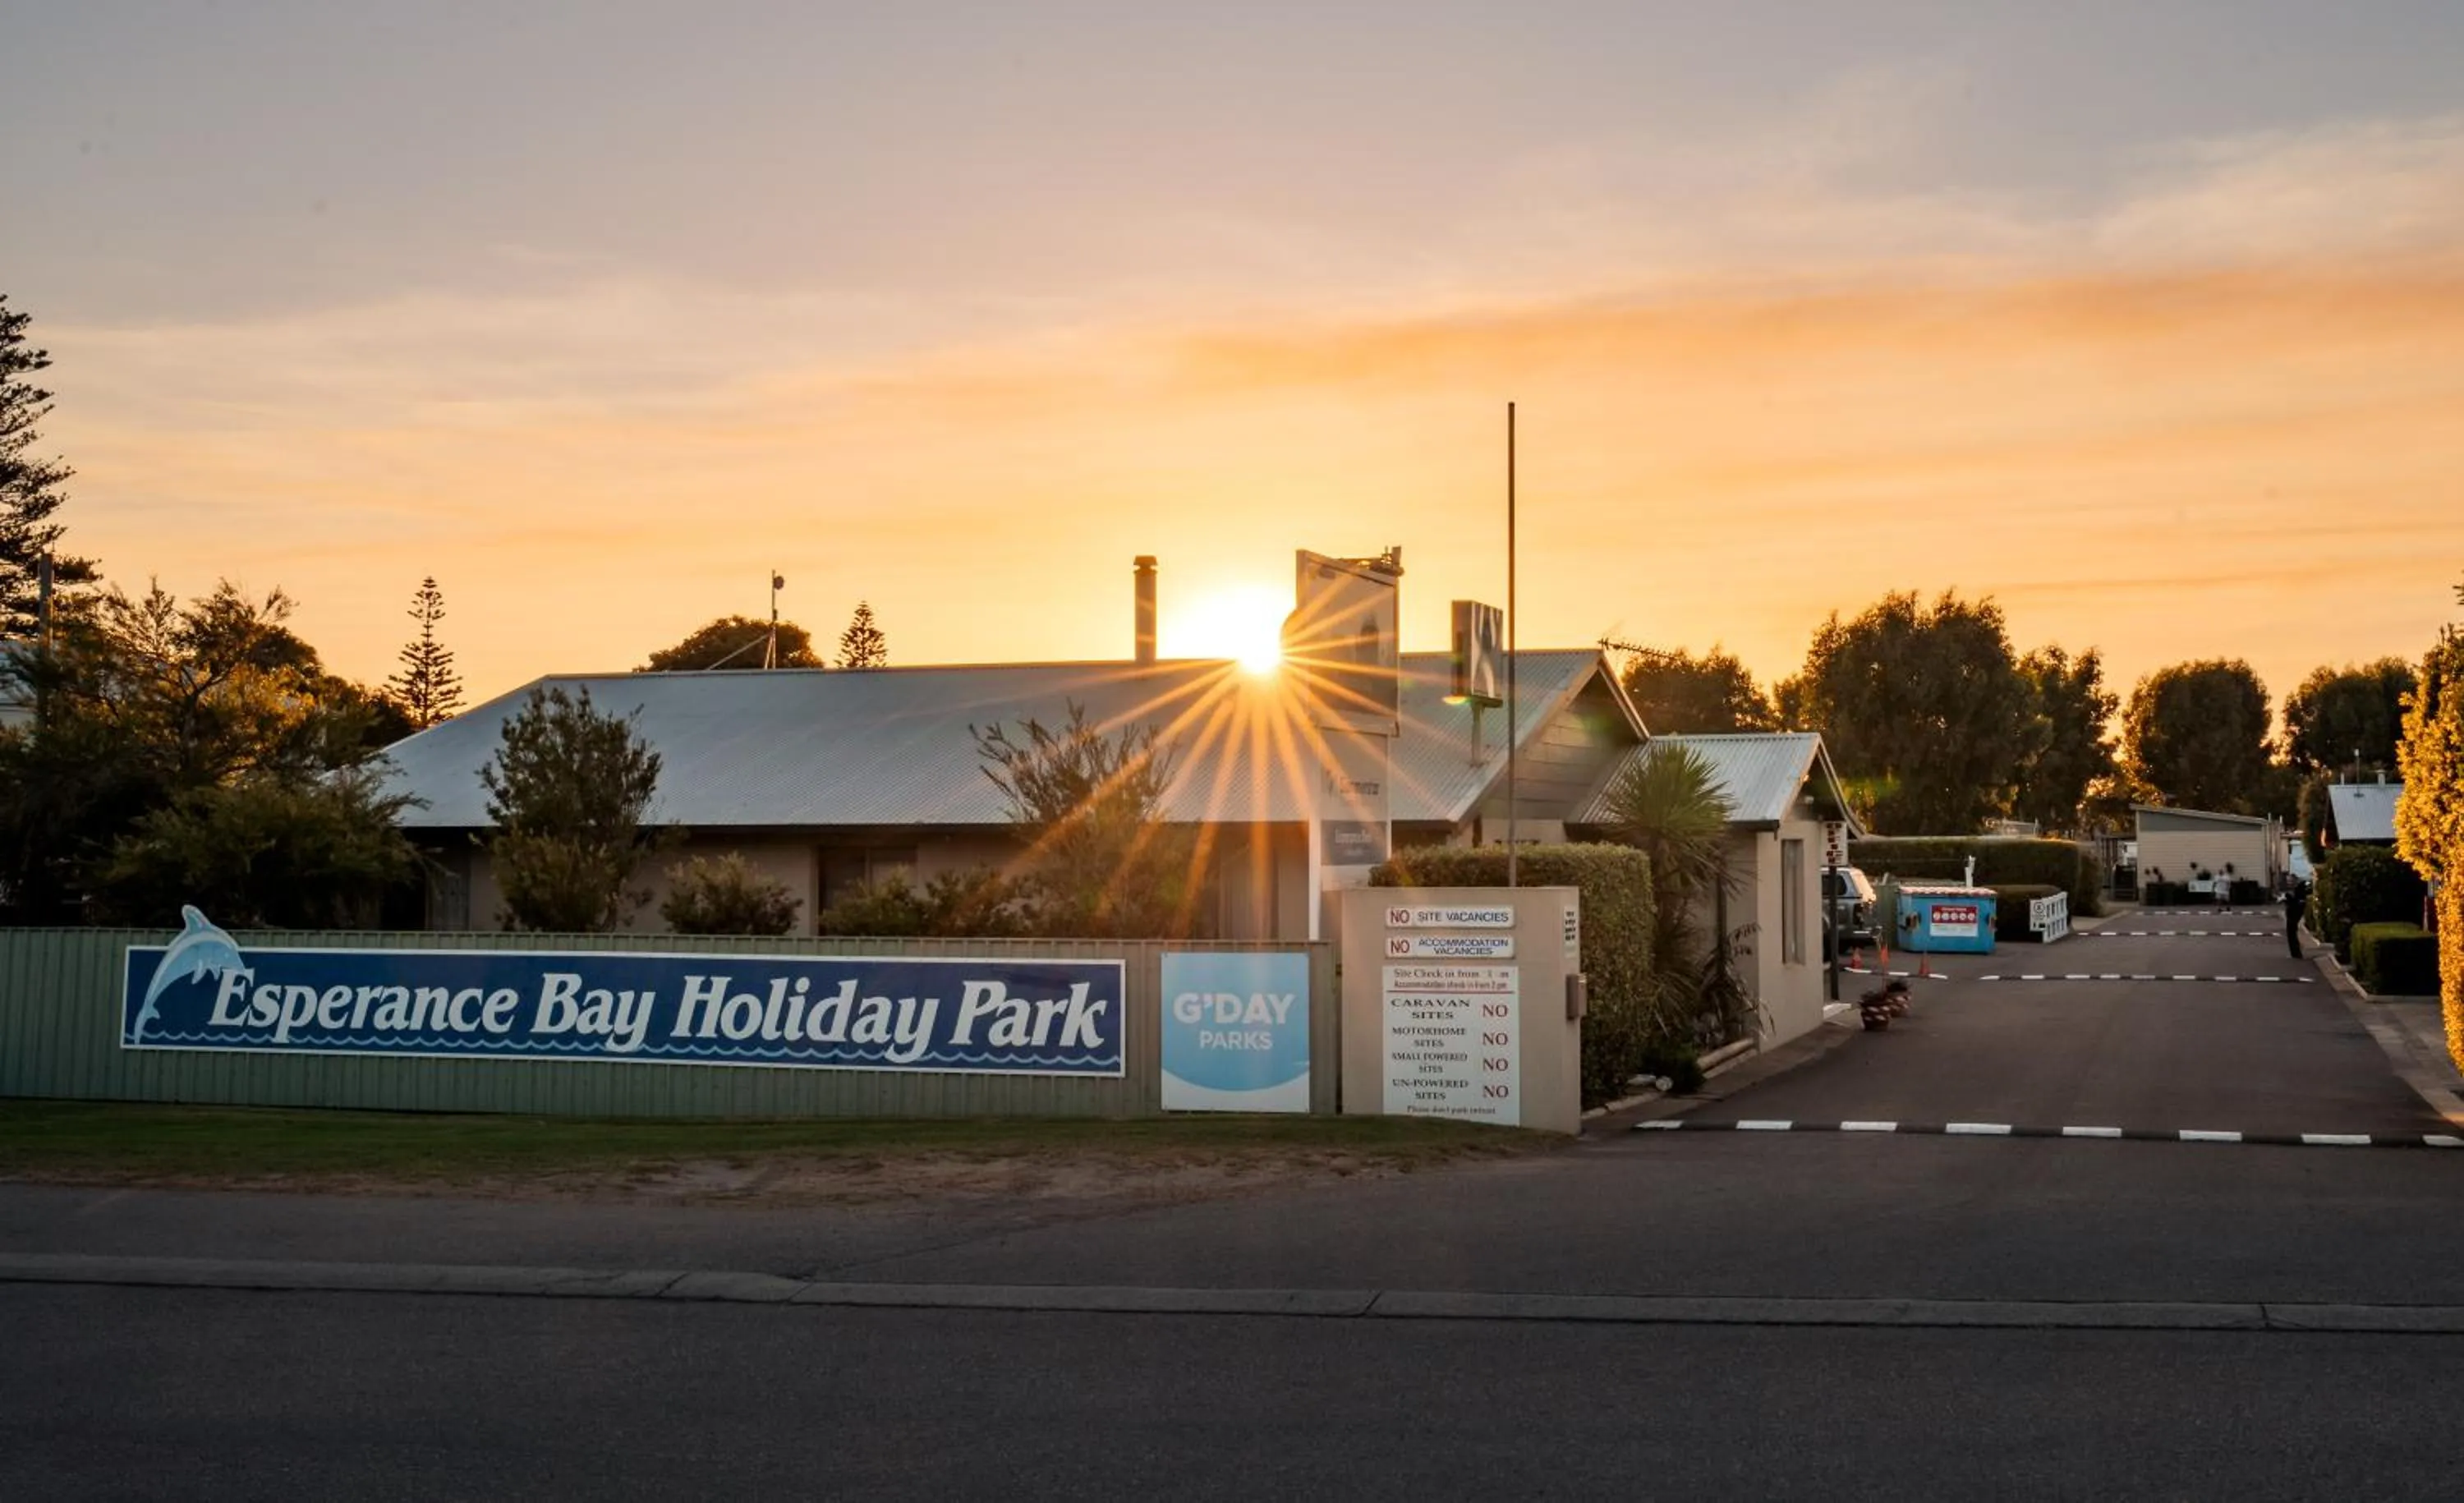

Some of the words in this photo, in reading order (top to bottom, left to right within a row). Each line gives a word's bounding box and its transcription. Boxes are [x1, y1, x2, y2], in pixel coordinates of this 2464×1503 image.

[1390, 910, 1410, 923] NO
[1417, 912, 1441, 922] SITE
[1446, 911, 1509, 923] VACANCIES
[1390, 940, 1410, 954] NO
[1418, 939, 1508, 947] ACCOMMODATION
[1433, 947, 1493, 955] VACANCIES
[1414, 968, 1442, 978] Check
[1173, 992, 1295, 1025] G'DAY
[1391, 999, 1470, 1008] CARAVAN
[209, 968, 519, 1043] Esperance
[531, 972, 655, 1054] Bay
[670, 976, 940, 1064] Holiday
[949, 980, 1107, 1047] Park
[1412, 1011, 1453, 1019] SITES
[1483, 1004, 1508, 1018] NO
[1392, 1027, 1466, 1036] MOTORHOME
[1199, 1030, 1273, 1050] PARKS
[1414, 1039, 1444, 1047] SITES
[1483, 1032, 1508, 1046] NO
[1423, 1052, 1468, 1062] POWERED
[1418, 1065, 1443, 1073] SITES
[1483, 1058, 1508, 1071] NO
[1392, 1078, 1469, 1088] UN-POWERED
[1415, 1092, 1446, 1101] SITES
[1483, 1085, 1509, 1098] NO
